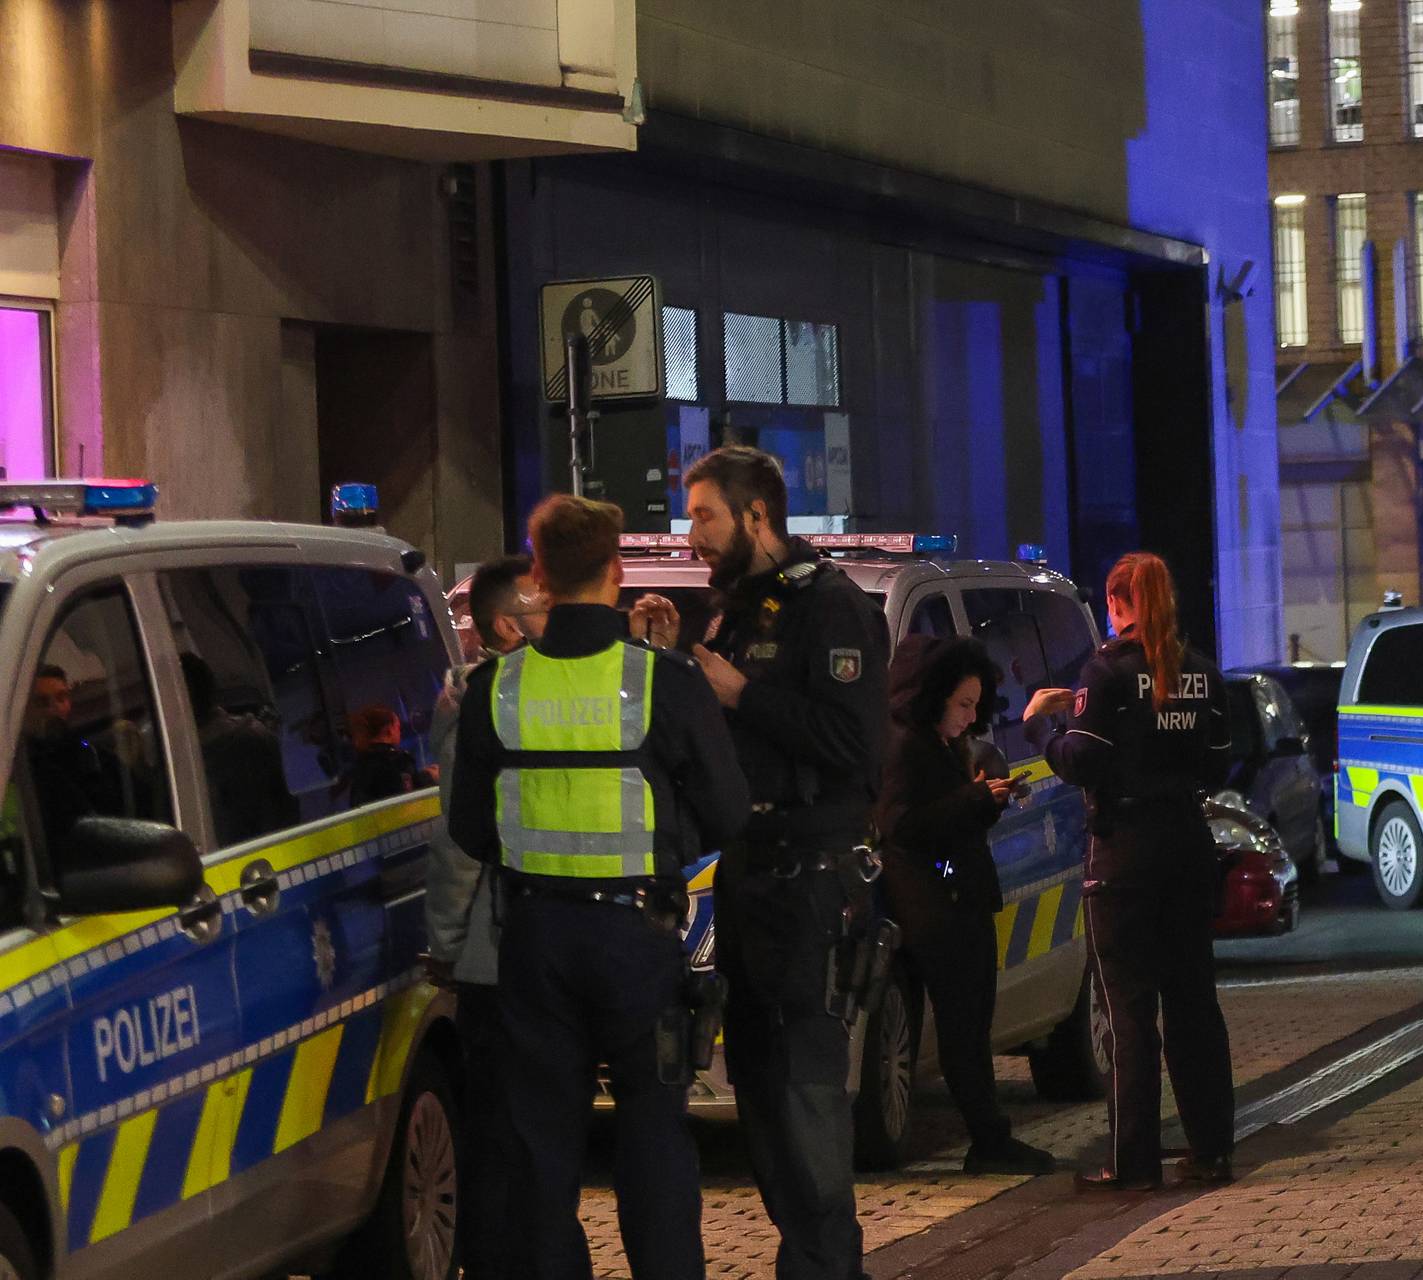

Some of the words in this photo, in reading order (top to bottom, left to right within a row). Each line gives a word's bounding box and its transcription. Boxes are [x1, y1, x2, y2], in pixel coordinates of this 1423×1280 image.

[590, 370, 630, 390] ONE
[1137, 673, 1209, 699] PIZEI
[525, 696, 614, 727] POLIZEI
[1157, 712, 1197, 731] NRW
[94, 984, 200, 1082] POLIZEI
